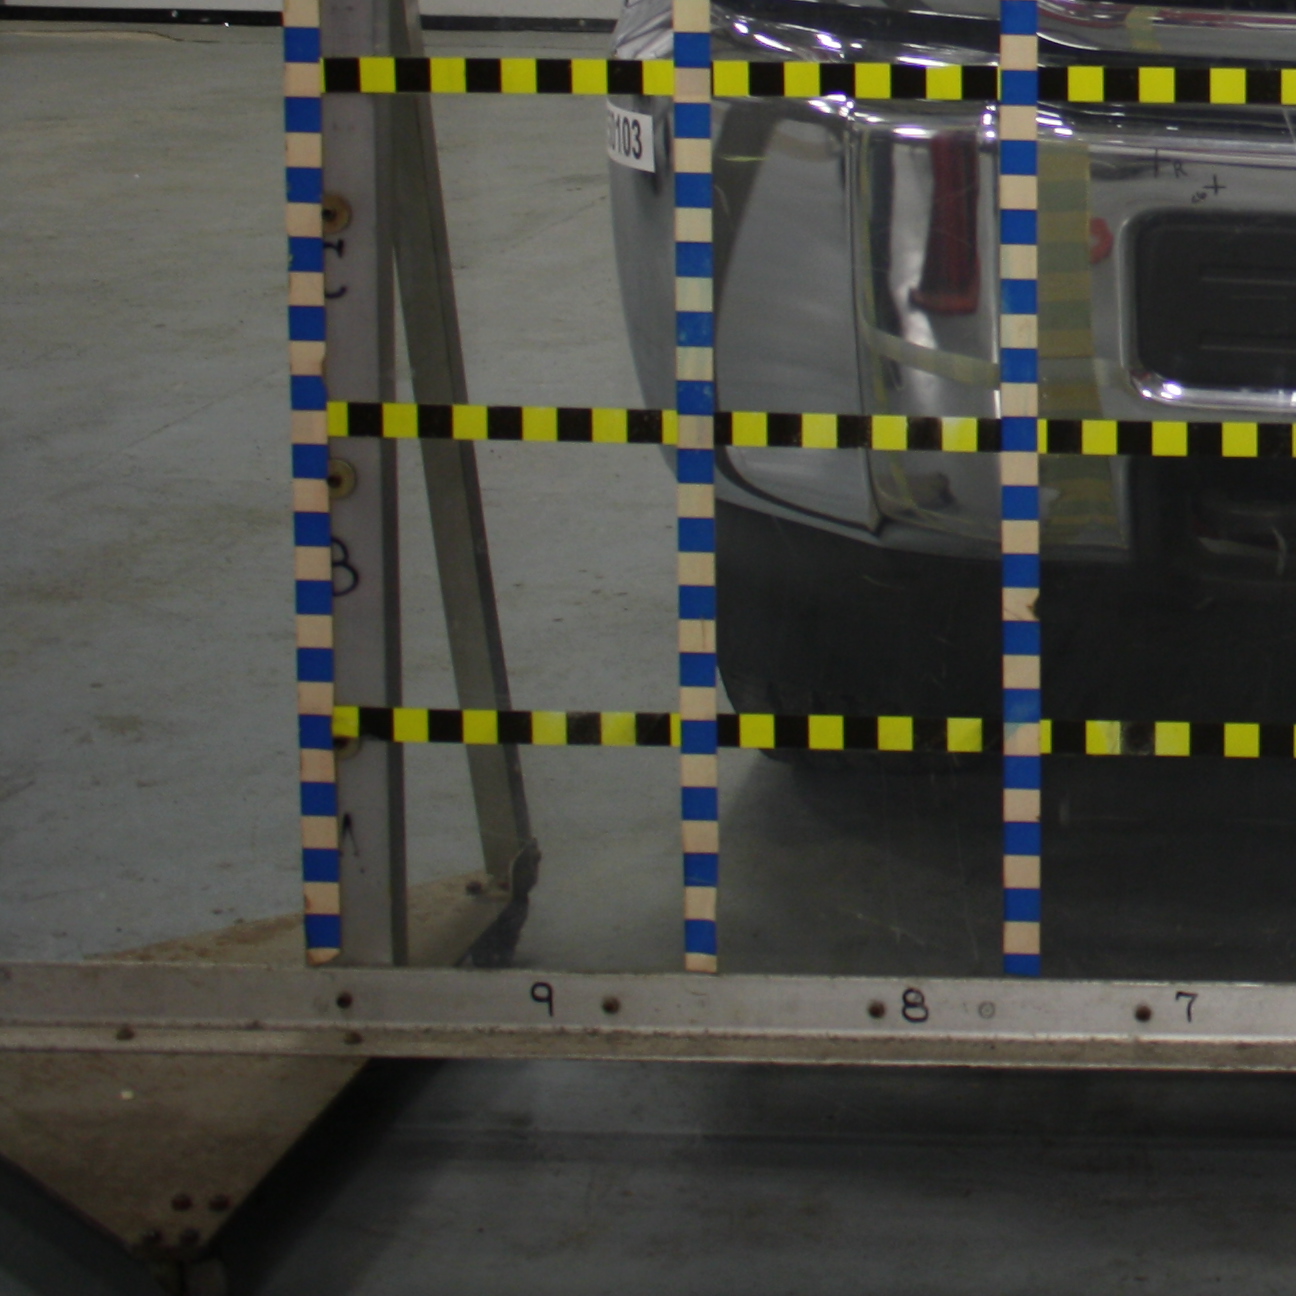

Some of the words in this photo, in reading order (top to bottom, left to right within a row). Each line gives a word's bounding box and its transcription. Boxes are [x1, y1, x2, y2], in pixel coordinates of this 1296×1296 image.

[530, 981, 555, 1017] 9
[901, 987, 930, 1023] 8
[1175, 991, 1198, 1023] 7
